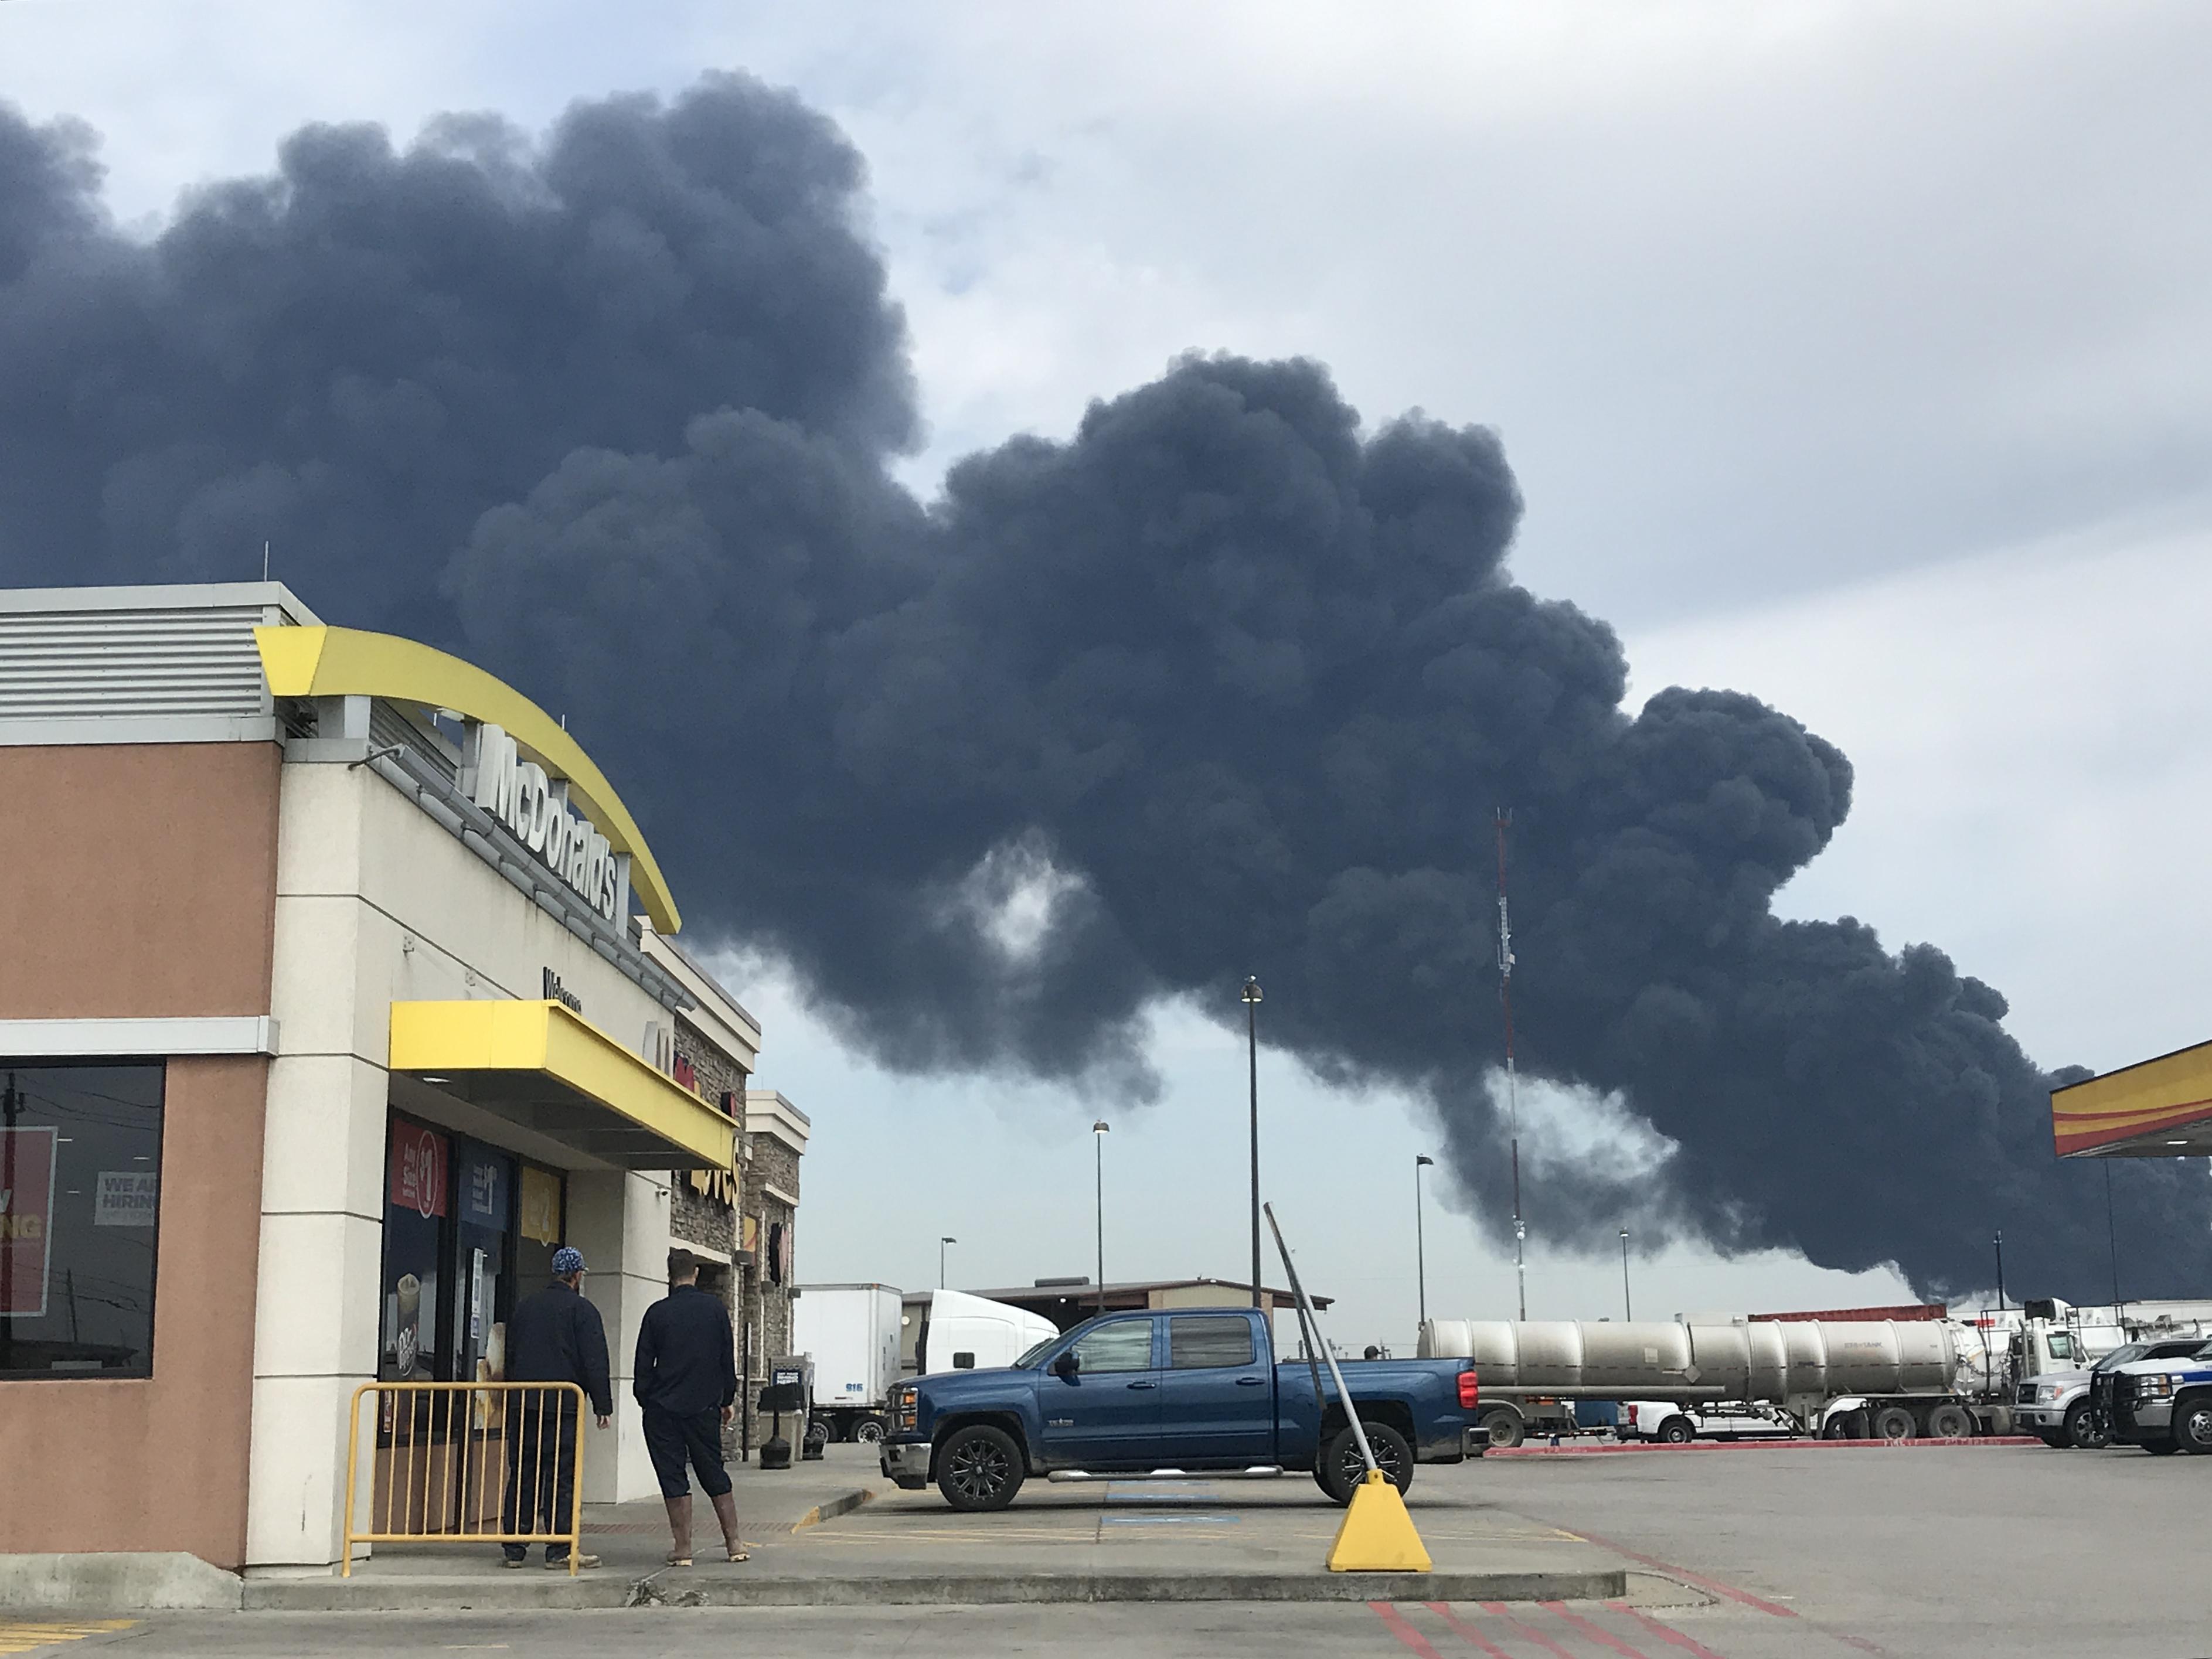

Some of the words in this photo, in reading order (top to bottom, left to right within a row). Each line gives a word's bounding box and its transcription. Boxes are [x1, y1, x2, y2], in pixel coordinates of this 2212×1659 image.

[475, 724, 616, 920] McDonald's
[104, 1177, 134, 1191] WE
[103, 1194, 155, 1209] HIRIN
